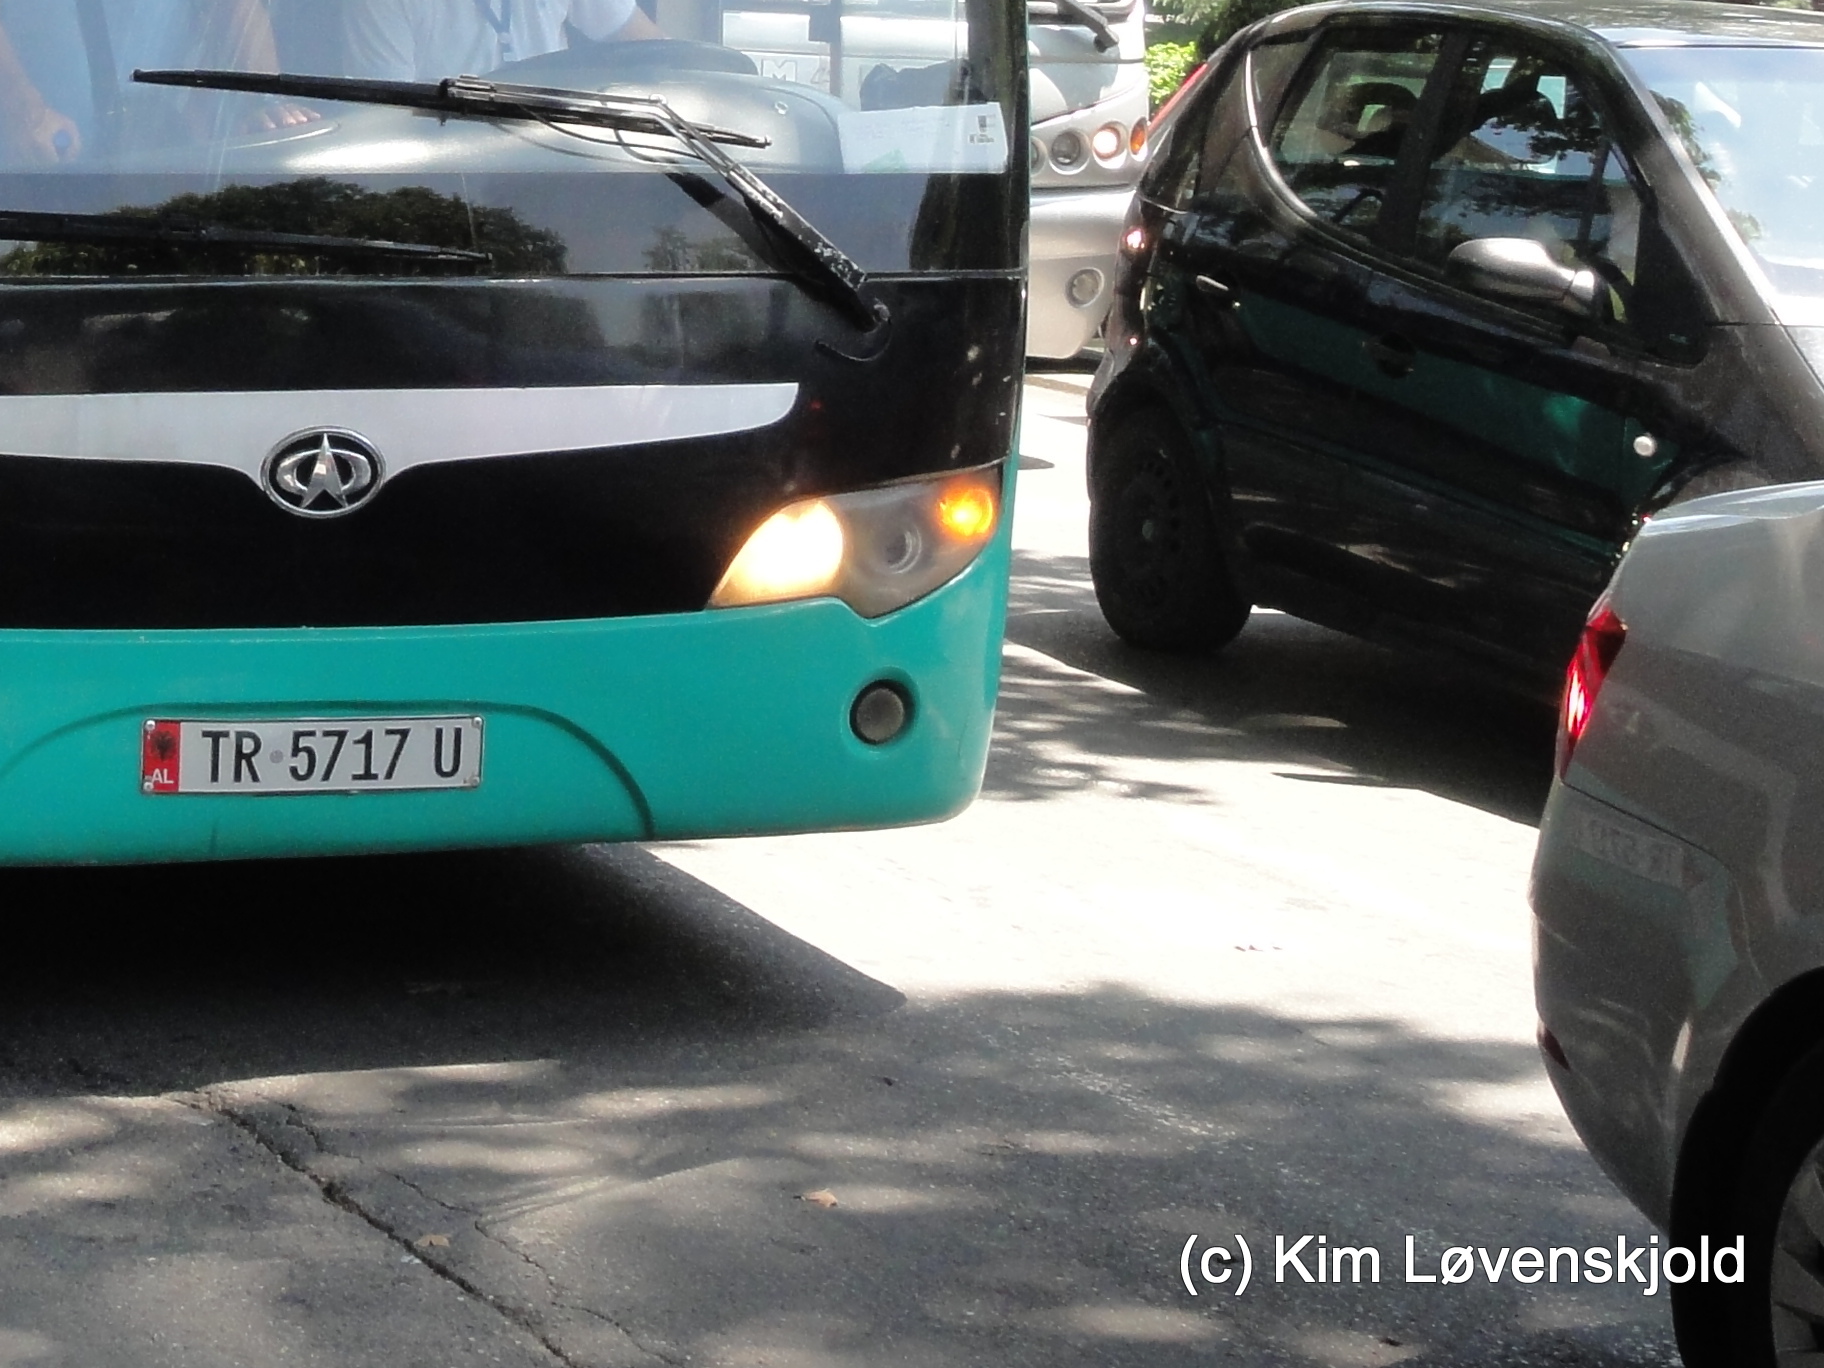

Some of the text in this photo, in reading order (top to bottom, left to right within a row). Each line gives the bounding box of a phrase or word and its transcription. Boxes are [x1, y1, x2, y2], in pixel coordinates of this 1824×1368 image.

[201, 727, 463, 783] TR 5717 U
[151, 768, 175, 784] AL
